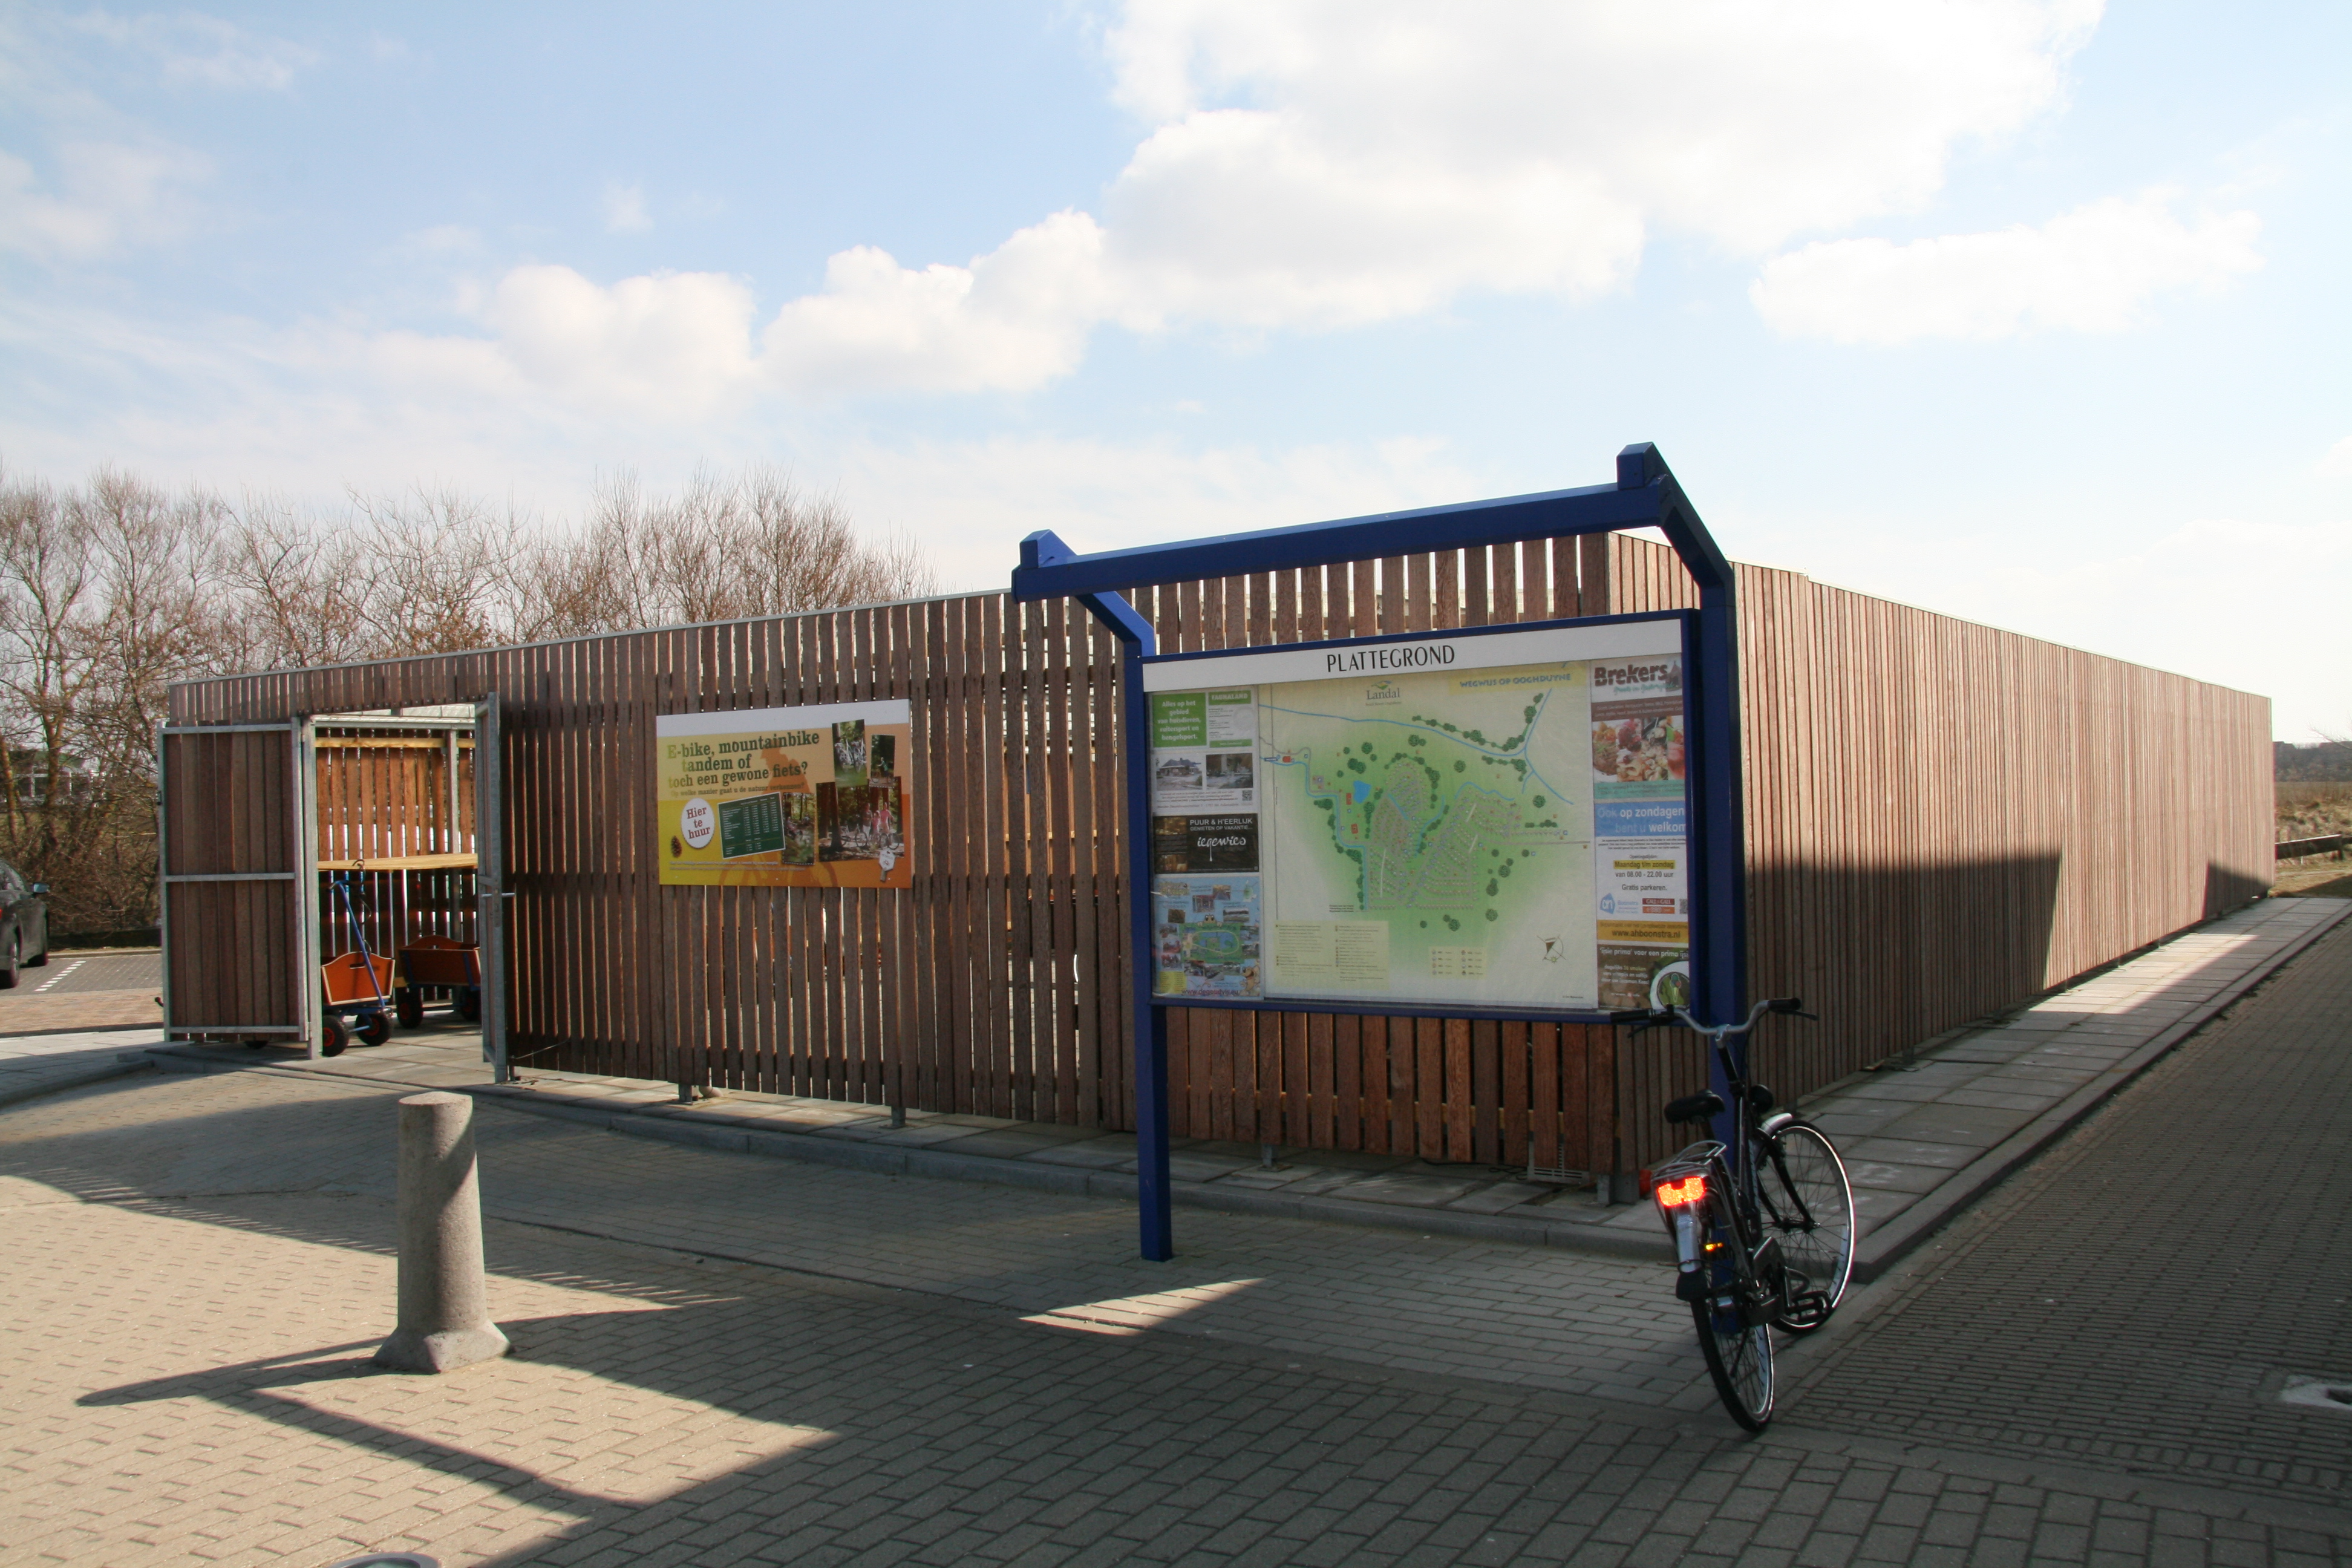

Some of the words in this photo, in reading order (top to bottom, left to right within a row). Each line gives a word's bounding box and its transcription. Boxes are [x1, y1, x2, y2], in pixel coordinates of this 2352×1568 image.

[1327, 644, 1455, 673] PLATTEGROND
[1460, 679, 1497, 688] WEGWIJS
[1514, 674, 1571, 684] OOGHDUYNE
[1594, 664, 1668, 686] Brekers
[1366, 687, 1400, 700] Landal
[1161, 733, 1198, 742] hengelsport.
[667, 742, 714, 759] E-bike,
[719, 731, 820, 754] mountainbike
[682, 757, 733, 772] tandem
[738, 753, 752, 769] of
[668, 774, 693, 788] toch
[697, 774, 718, 785] een
[722, 769, 769, 787] gewone
[773, 761, 808, 777] fiets?
[681, 788, 696, 796] welke
[719, 787, 732, 795] gaat
[769, 782, 805, 791] verkennen?
[686, 807, 707, 819] Hier
[1598, 808, 1617, 818] Ook
[1619, 808, 1633, 820] op
[1635, 805, 1685, 820] zondagen
[693, 819, 703, 828] te
[1615, 823, 1636, 833] bent
[688, 826, 711, 839] huur
[1612, 929, 1681, 938] www.ahboonstra.nl
